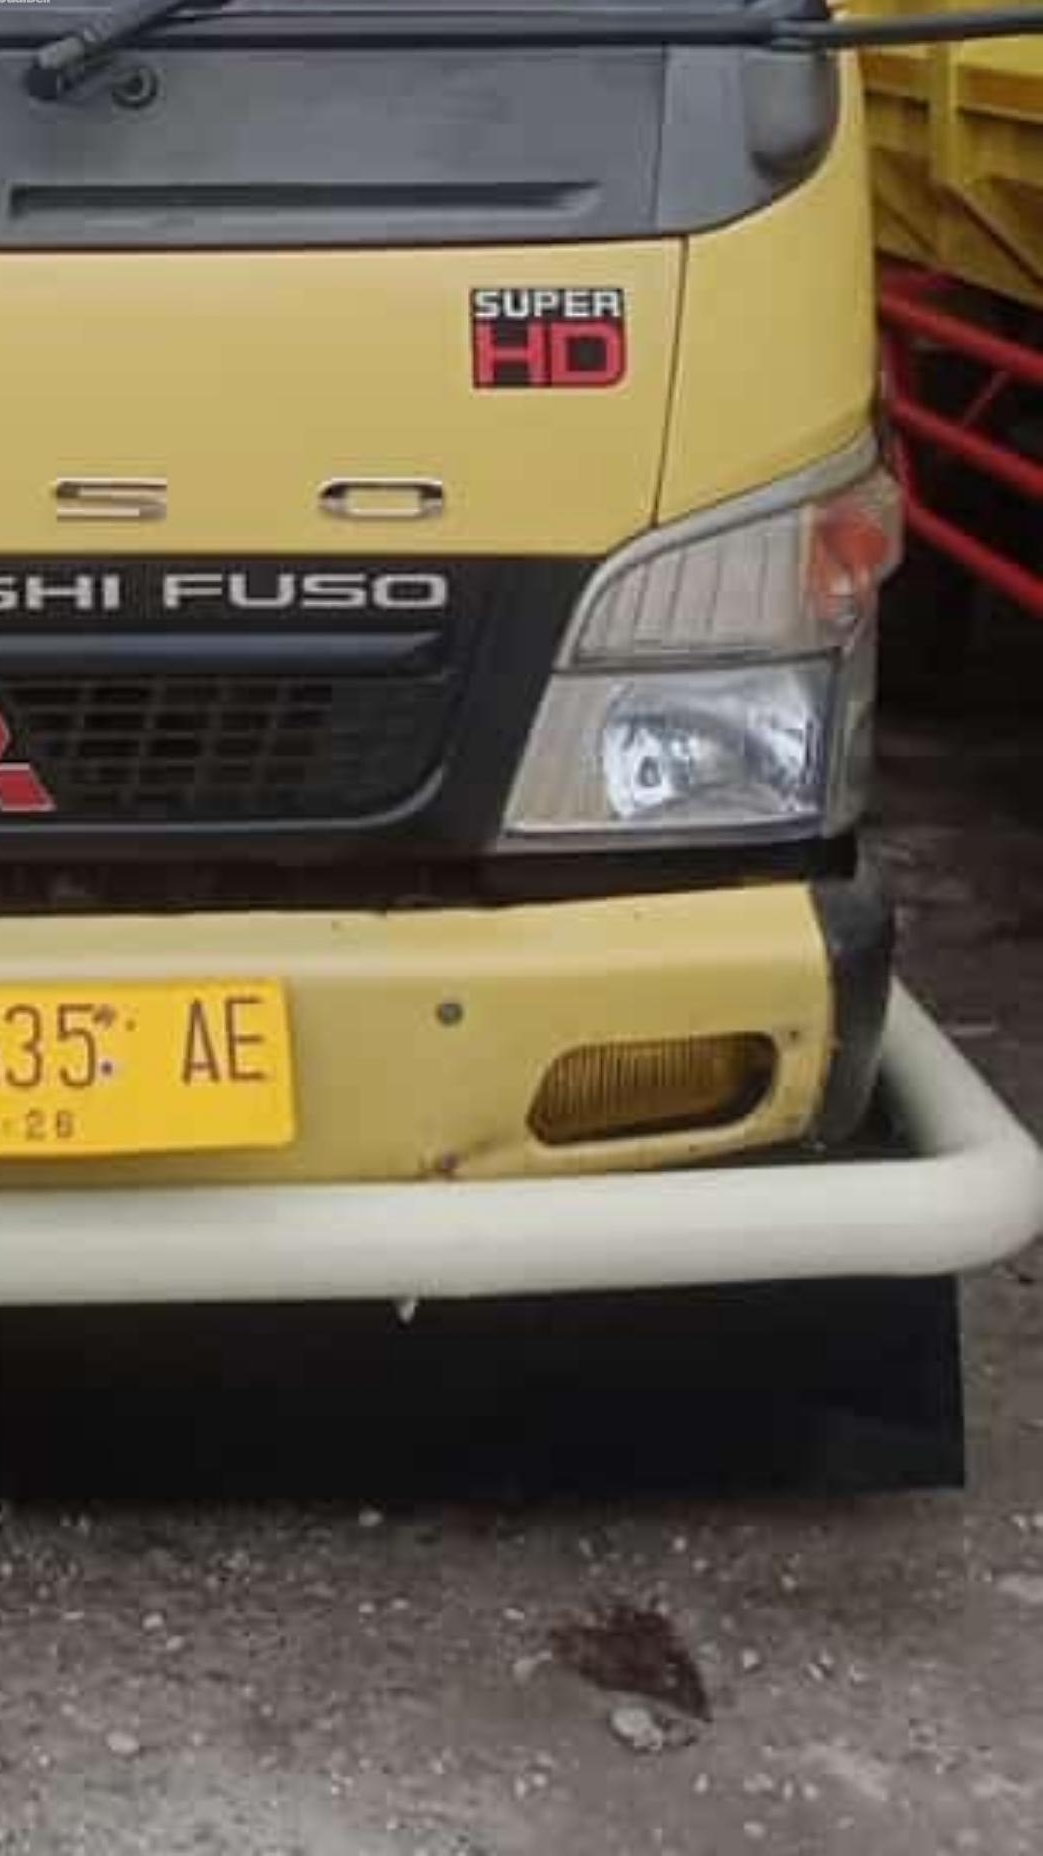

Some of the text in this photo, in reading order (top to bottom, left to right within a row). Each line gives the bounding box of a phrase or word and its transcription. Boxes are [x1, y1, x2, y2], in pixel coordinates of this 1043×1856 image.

[474, 289, 621, 318] SUPER
[475, 321, 624, 383] HD
[162, 573, 450, 610] FUSO
[182, 996, 267, 1084] AE
